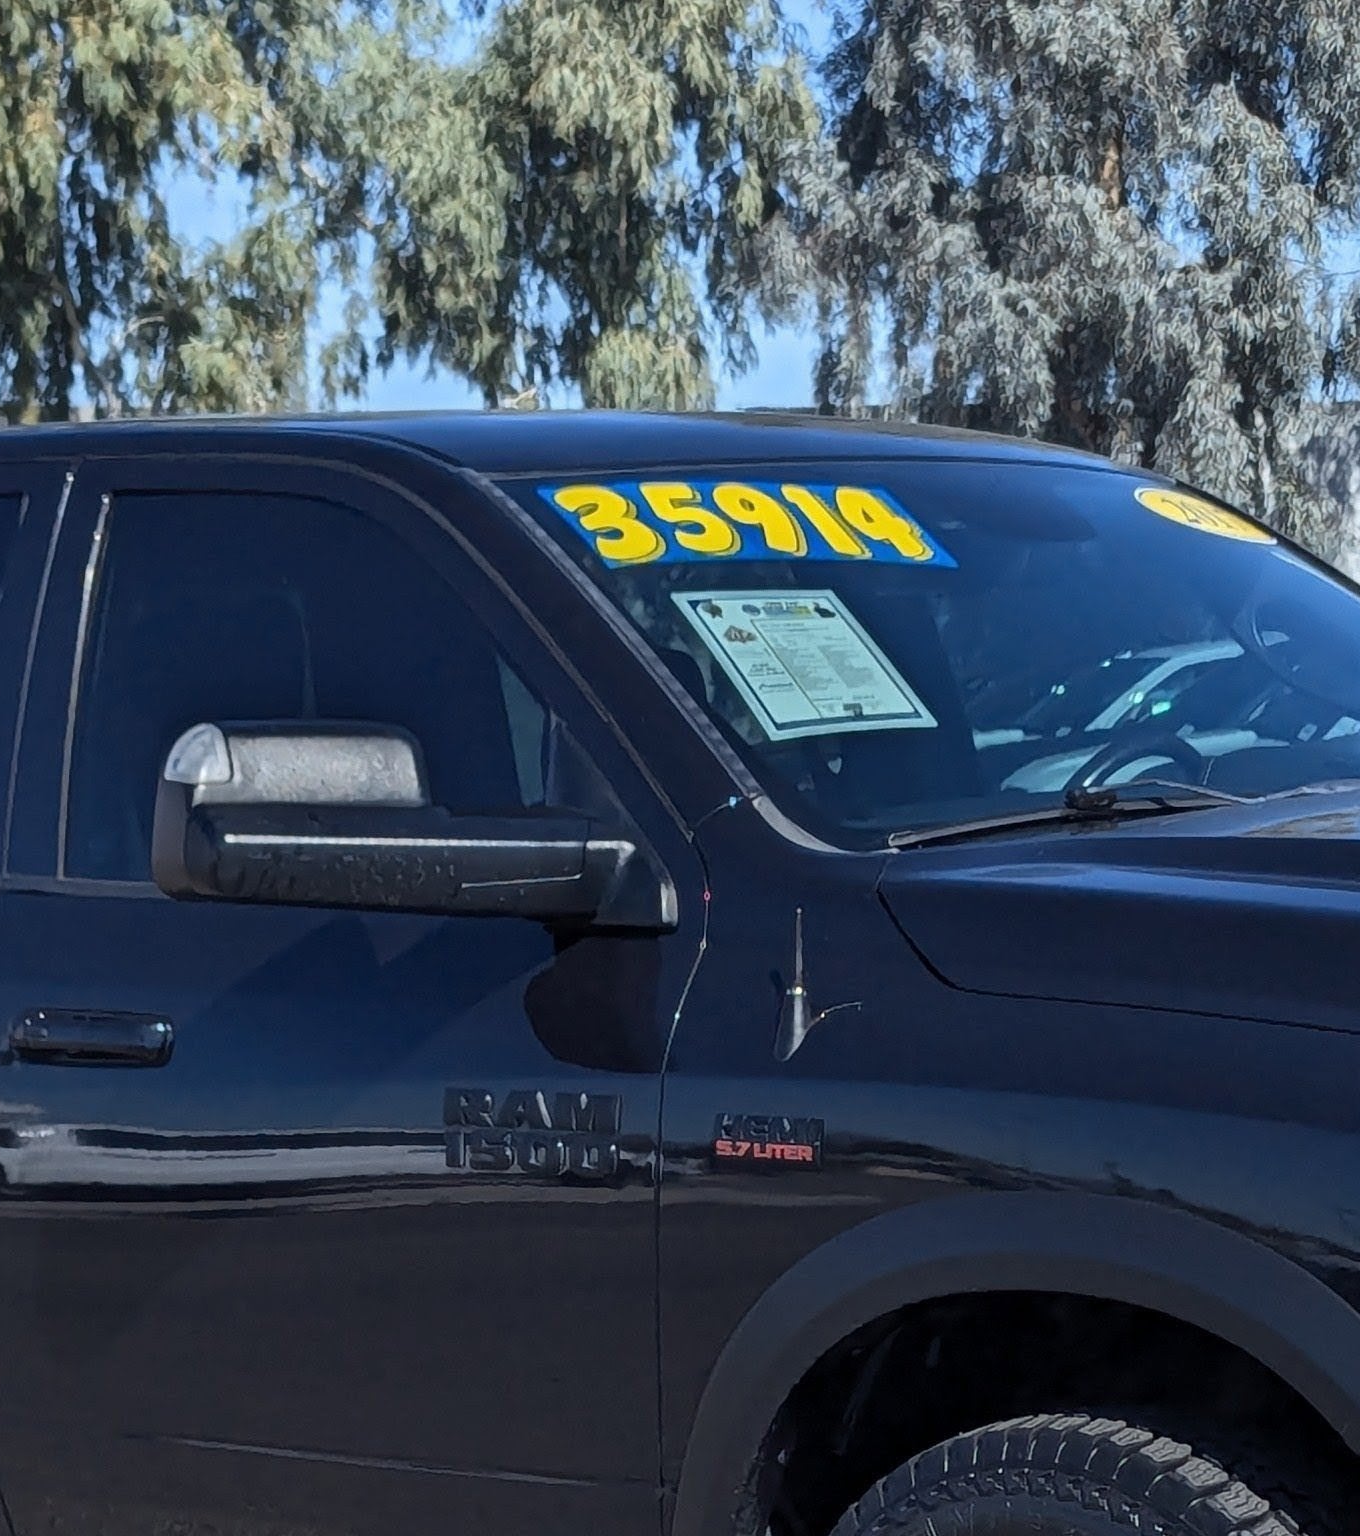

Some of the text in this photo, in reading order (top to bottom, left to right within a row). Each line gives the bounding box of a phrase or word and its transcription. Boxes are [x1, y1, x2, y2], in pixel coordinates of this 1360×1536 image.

[553, 481, 935, 565] 35914
[443, 1086, 622, 1132] RAM
[444, 1129, 618, 1178] 1500
[715, 1139, 813, 1161] 5.7 LITER
